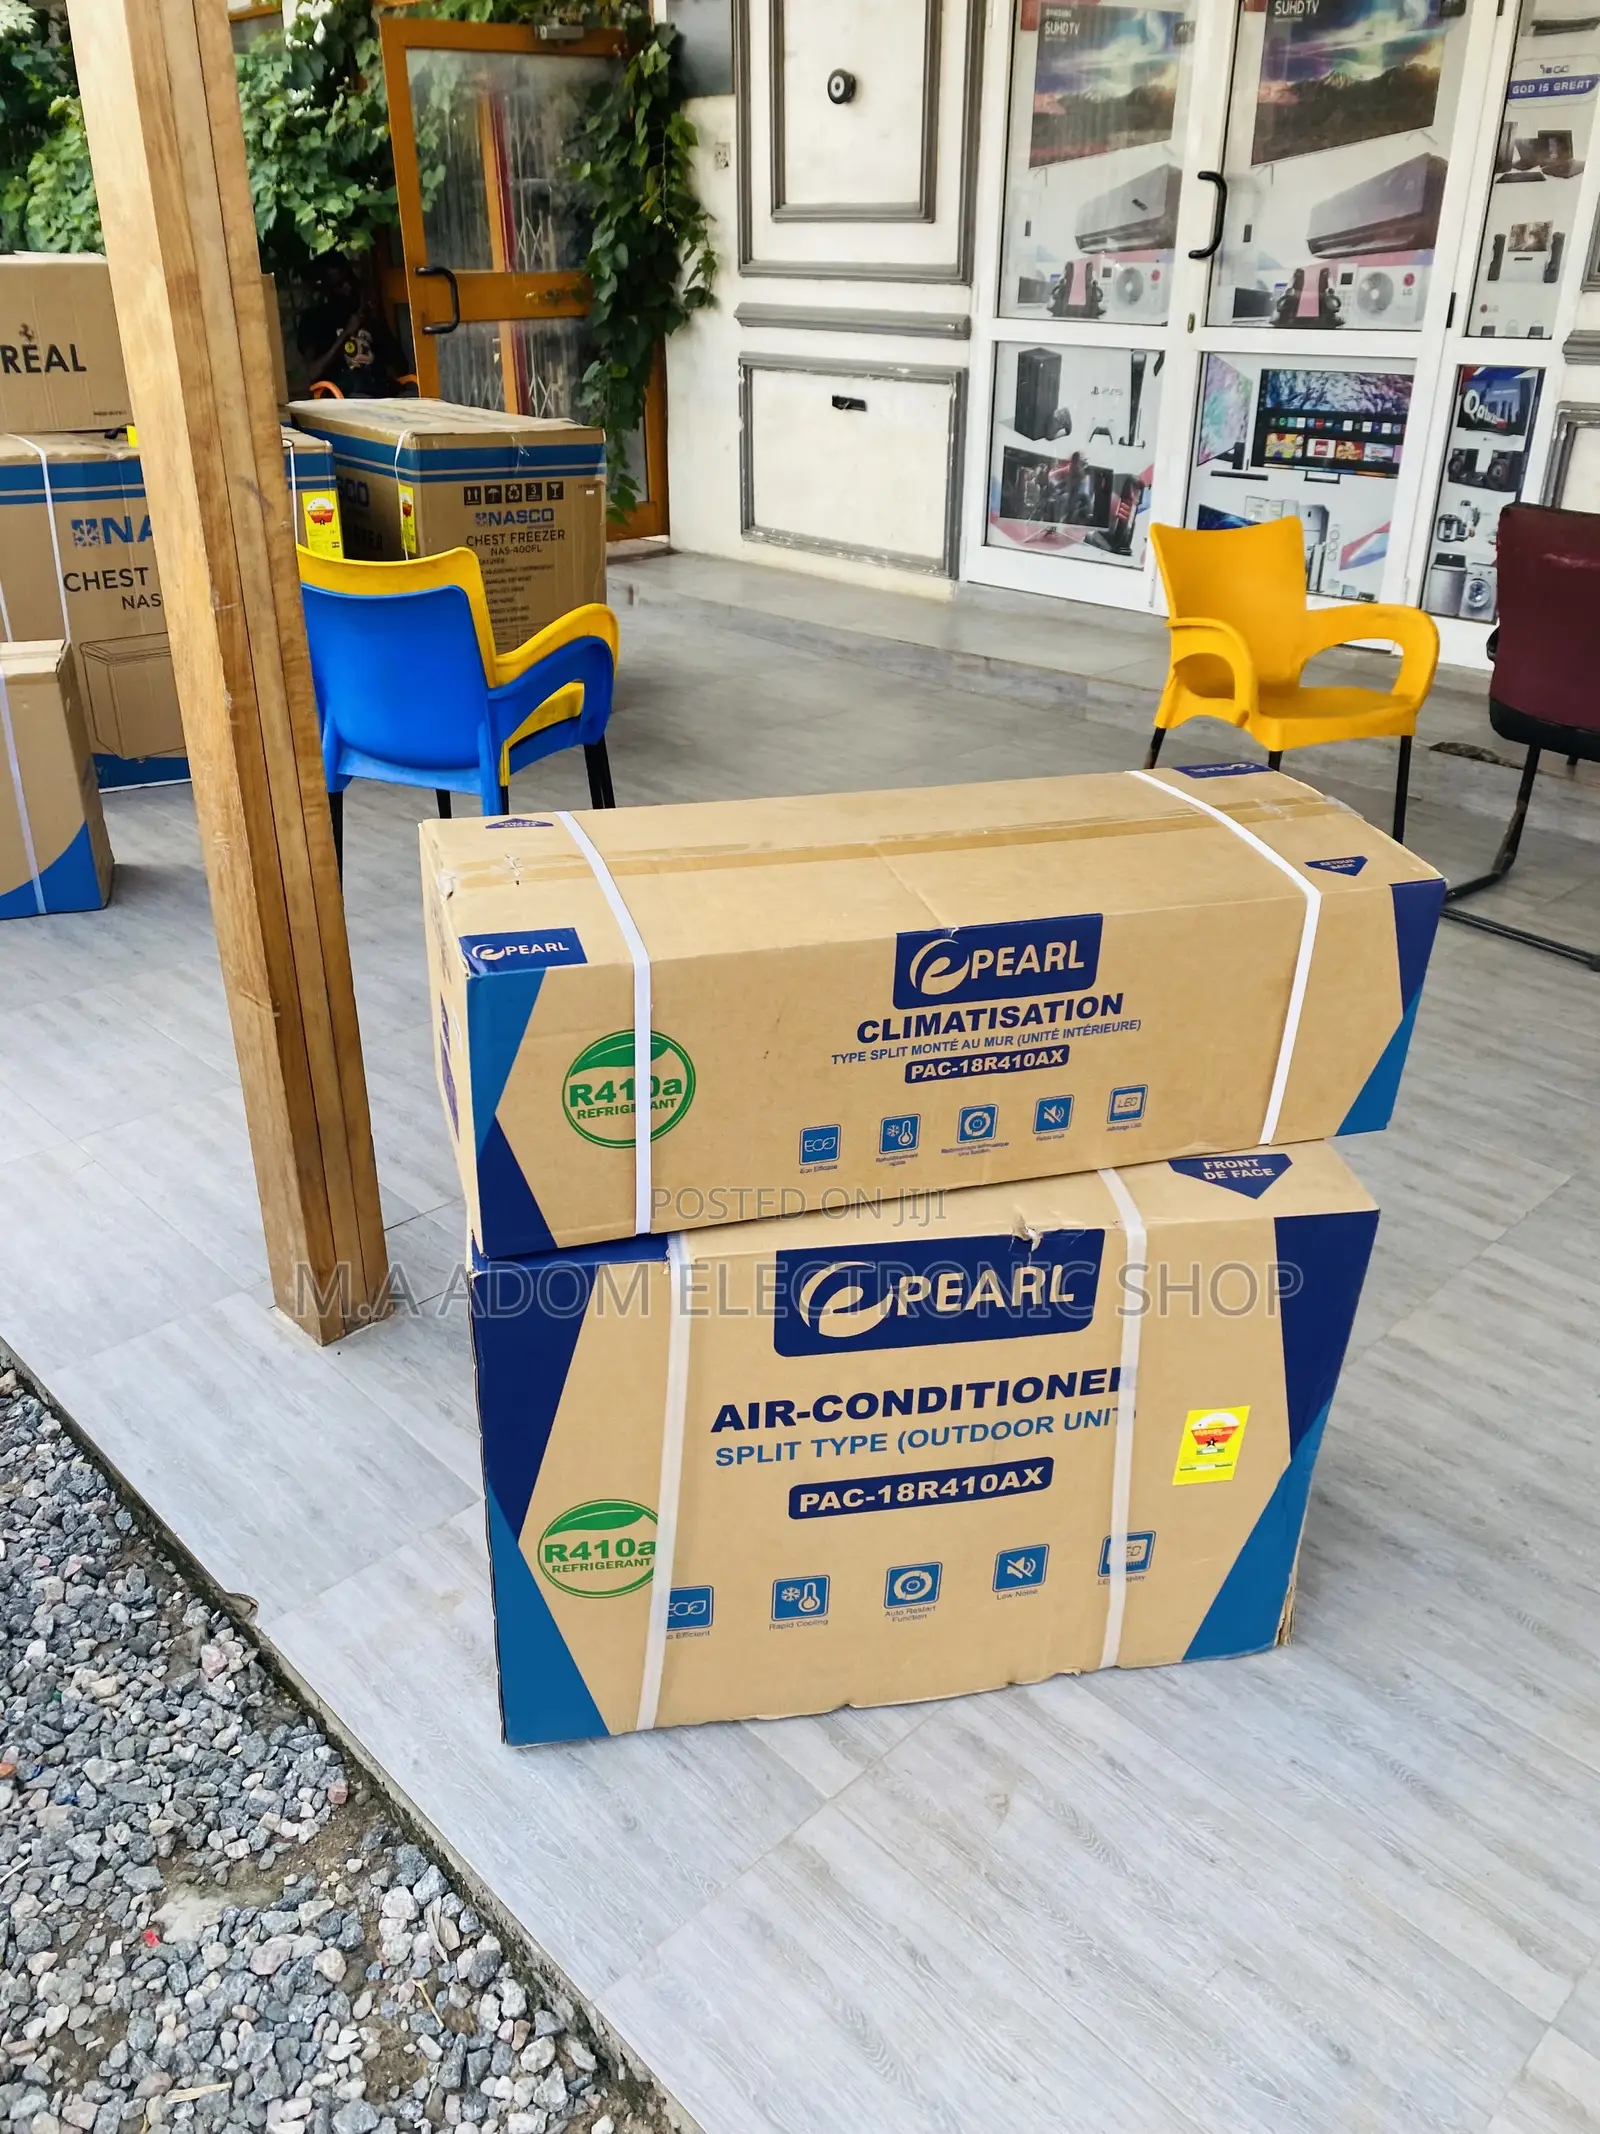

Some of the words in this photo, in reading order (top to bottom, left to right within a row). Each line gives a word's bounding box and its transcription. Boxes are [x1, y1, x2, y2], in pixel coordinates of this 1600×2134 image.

[1512, 84, 1535, 94] GOD
[1538, 83, 1549, 92] IS
[1553, 80, 1592, 91] GREAT
[489, 508, 555, 526] NASCO
[101, 514, 153, 545] NA
[466, 533, 506, 547] CHEST
[510, 529, 566, 544] FREEZER
[63, 567, 149, 593] CHEST
[121, 593, 162, 610] NAS
[856, 993, 1125, 1044] CLIMATISATION
[831, 1051, 866, 1065] TYPE
[870, 1047, 909, 1061] SPLIT
[911, 1039, 960, 1057] MONTÉ
[961, 1038, 981, 1050] AU
[984, 1035, 1014, 1049] MUR
[1017, 1027, 1060, 1047] (UNITÉ
[1062, 1019, 1142, 1041] INTÉRIEURE)
[911, 1049, 1065, 1080] PAC-18R410AX
[577, 1099, 677, 1119] REFRIGANT
[1202, 1158, 1259, 1170] FRONT
[1204, 1169, 1228, 1180] DE
[1231, 1167, 1275, 1179] FACE
[715, 1441, 802, 1467] SPLIT
[814, 1433, 888, 1457] TYPE
[897, 1414, 1054, 1454] (OUTDOOR
[799, 1466, 1045, 1513] PAC-18R410AX
[544, 1537, 656, 1563] R410a
[552, 1557, 652, 1573] REFRIGERANT
[996, 1593, 1013, 1601] Low
[1015, 1589, 1039, 1597] Noise
[884, 1609, 904, 1618] Auto
[906, 1605, 936, 1615] Restart
[892, 1614, 927, 1623] Function
[769, 1622, 794, 1631] Rapid
[796, 1619, 829, 1629] Cooling
[676, 1630, 711, 1640] Efficient
